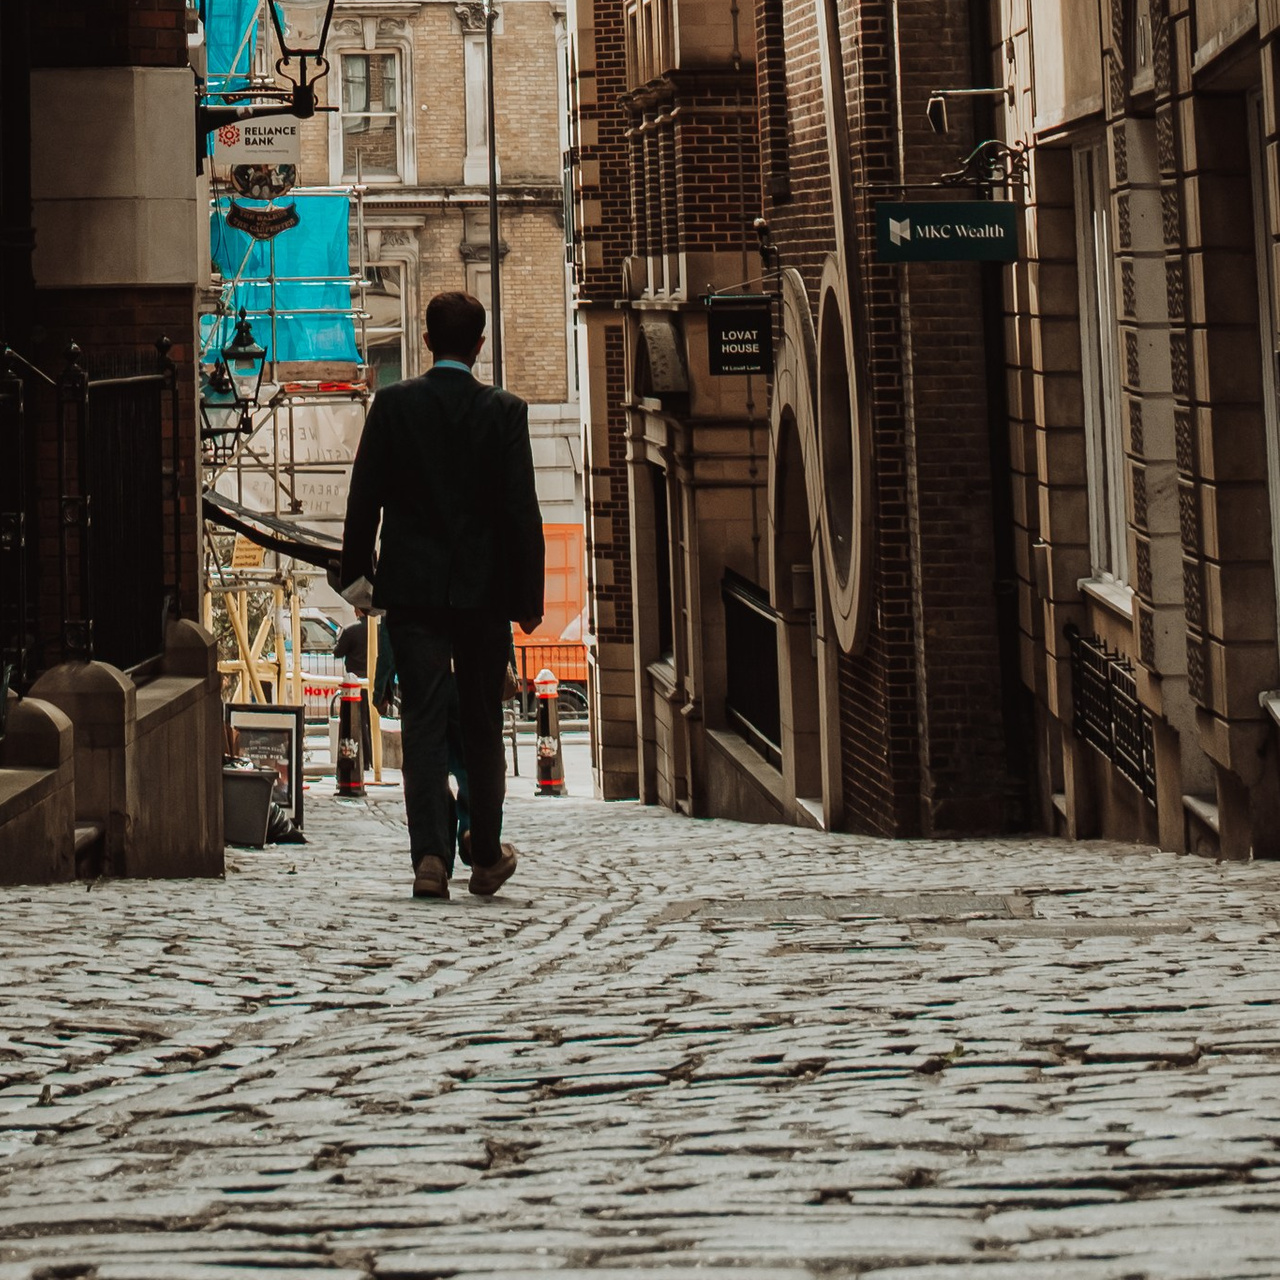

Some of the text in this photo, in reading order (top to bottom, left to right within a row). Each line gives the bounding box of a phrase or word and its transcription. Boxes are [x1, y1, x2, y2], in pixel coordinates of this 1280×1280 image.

[244, 126, 296, 136] RELIANCE
[244, 137, 274, 146] BANK
[233, 218, 249, 229] THE
[250, 218, 296, 232] CARPENTER
[916, 224, 1004, 239] MKC Wealth
[722, 330, 758, 340] LOVAT
[722, 344, 760, 353] HOUSE
